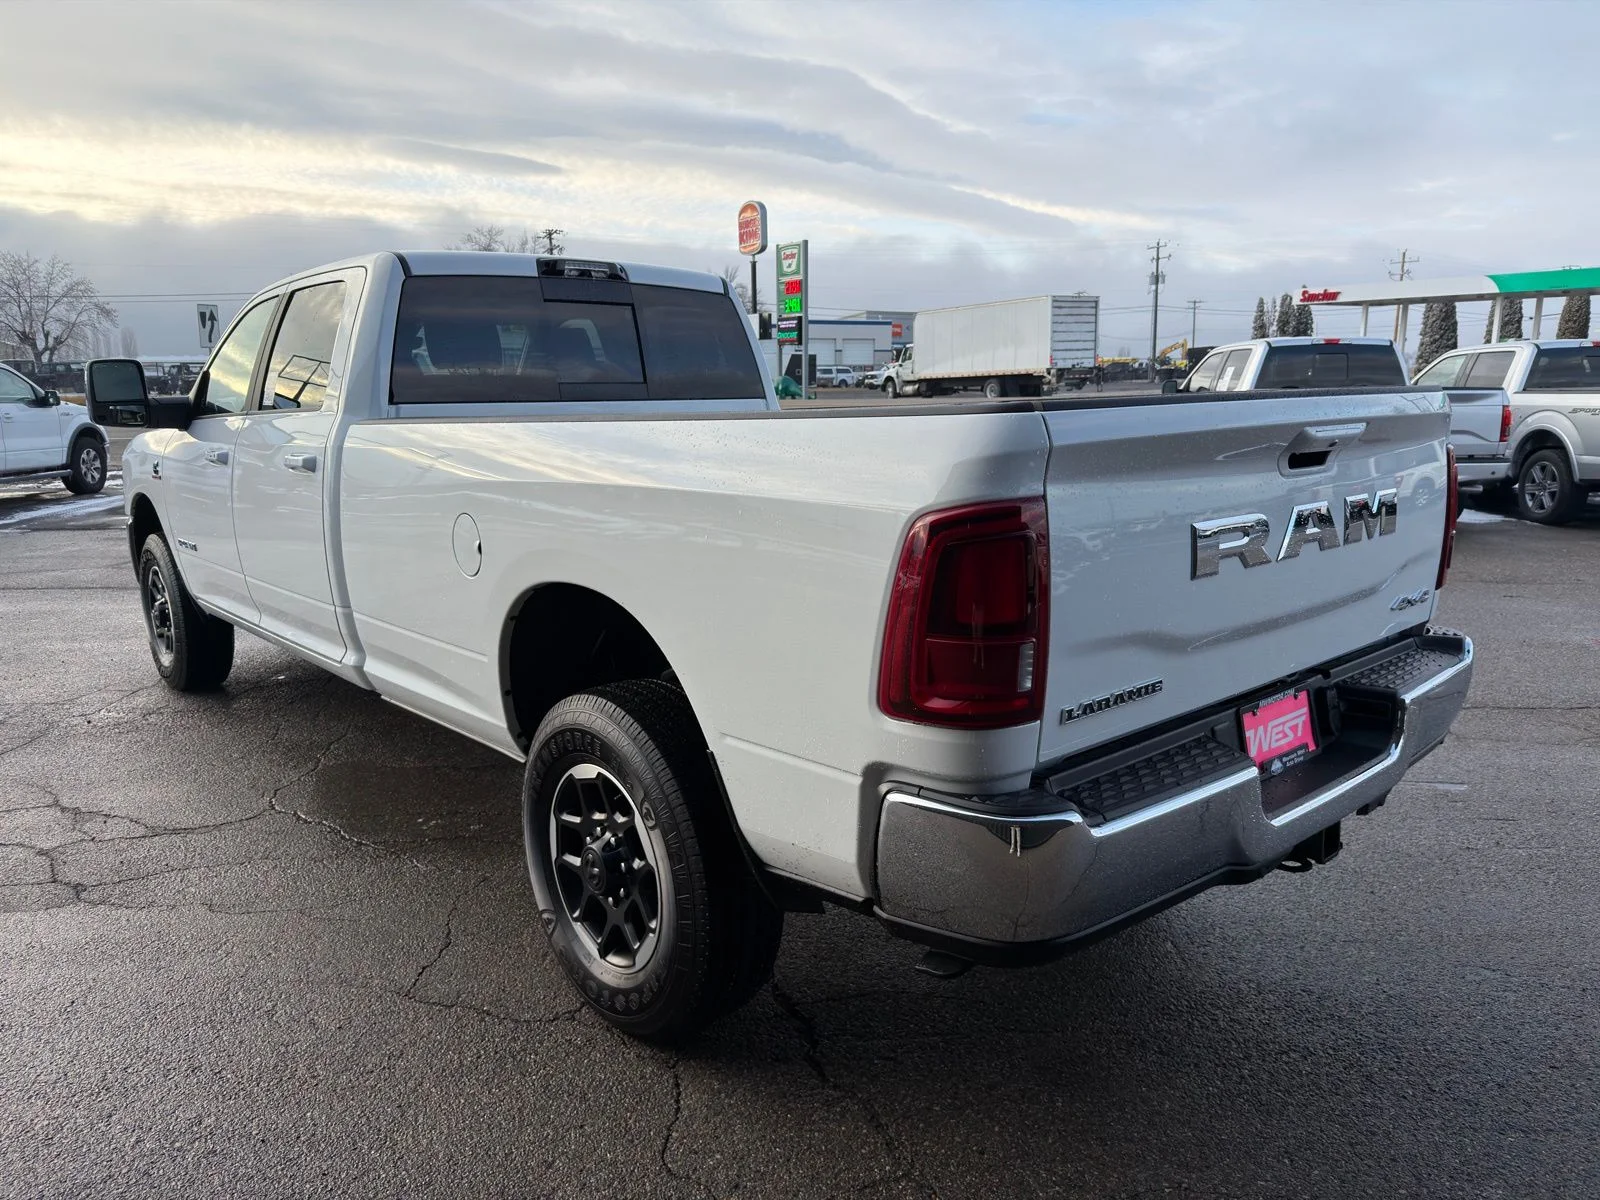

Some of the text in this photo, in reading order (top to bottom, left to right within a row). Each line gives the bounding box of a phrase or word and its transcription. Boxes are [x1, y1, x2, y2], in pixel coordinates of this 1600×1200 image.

[739, 228, 760, 246] KING
[1300, 289, 1341, 302] Sinclair
[1190, 487, 1398, 581] RAM
[1059, 677, 1163, 725] LARAMIE
[1245, 707, 1308, 758] WEST
